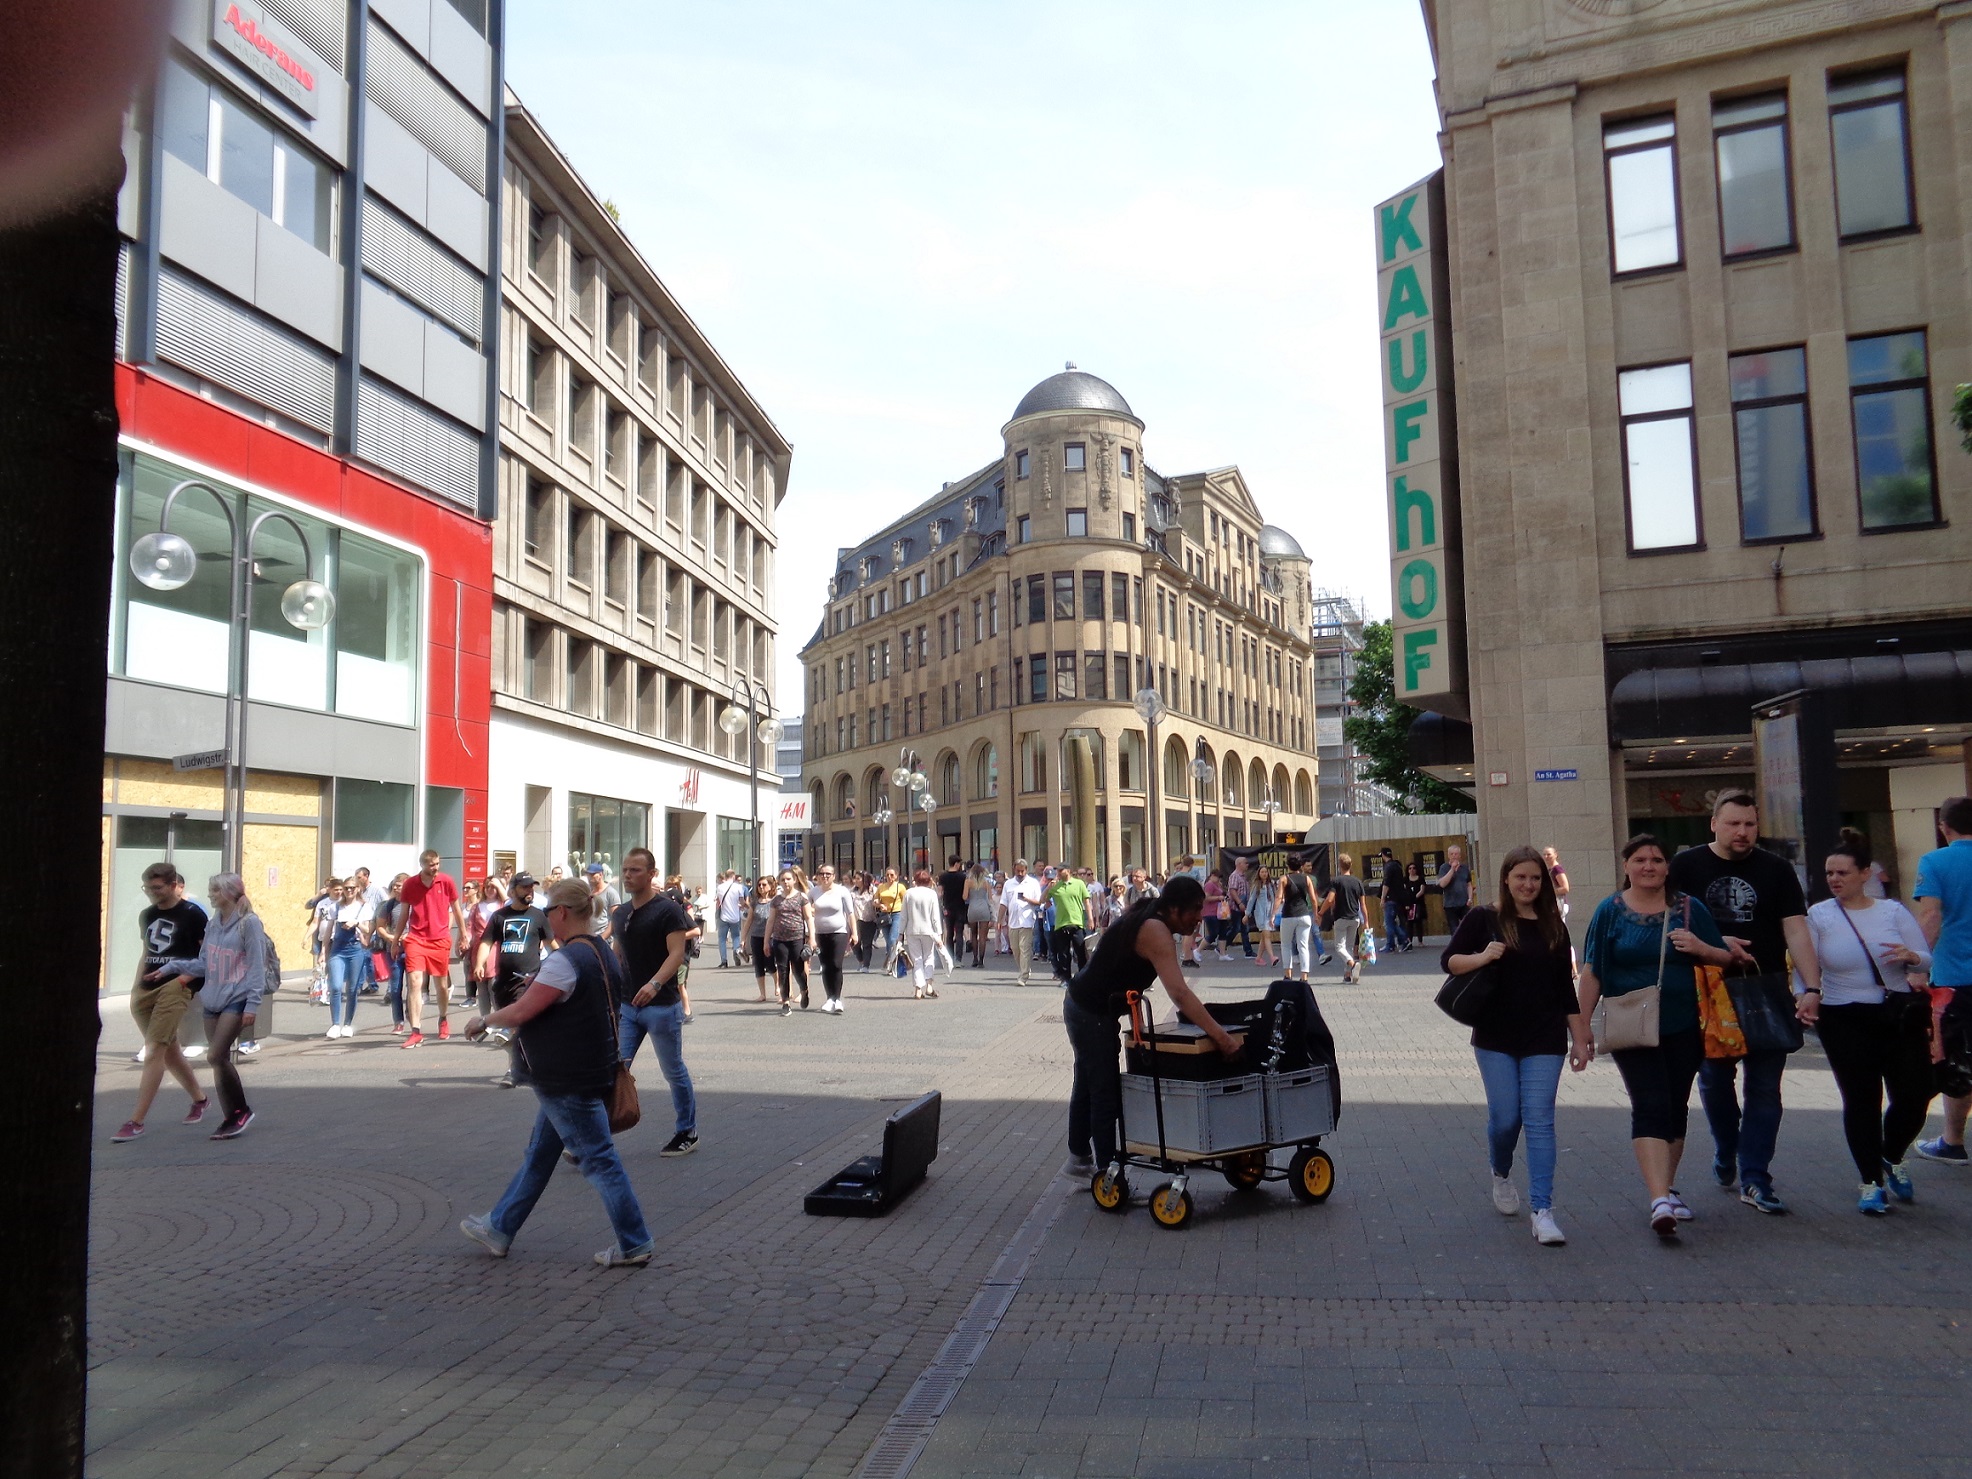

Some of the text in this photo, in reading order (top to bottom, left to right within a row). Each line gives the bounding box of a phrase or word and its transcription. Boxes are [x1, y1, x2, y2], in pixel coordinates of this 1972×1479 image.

[223, 3, 313, 91] Aderans
[233, 40, 301, 101] HAIR CENTER
[180, 753, 224, 768] Ludwigstr.
[1546, 771, 1555, 779] St.
[1555, 770, 1577, 780] Agatha
[780, 802, 806, 819] H&M
[1258, 852, 1289, 868] WIR
[1371, 870, 1384, 878] UM
[1424, 867, 1437, 875] UM
